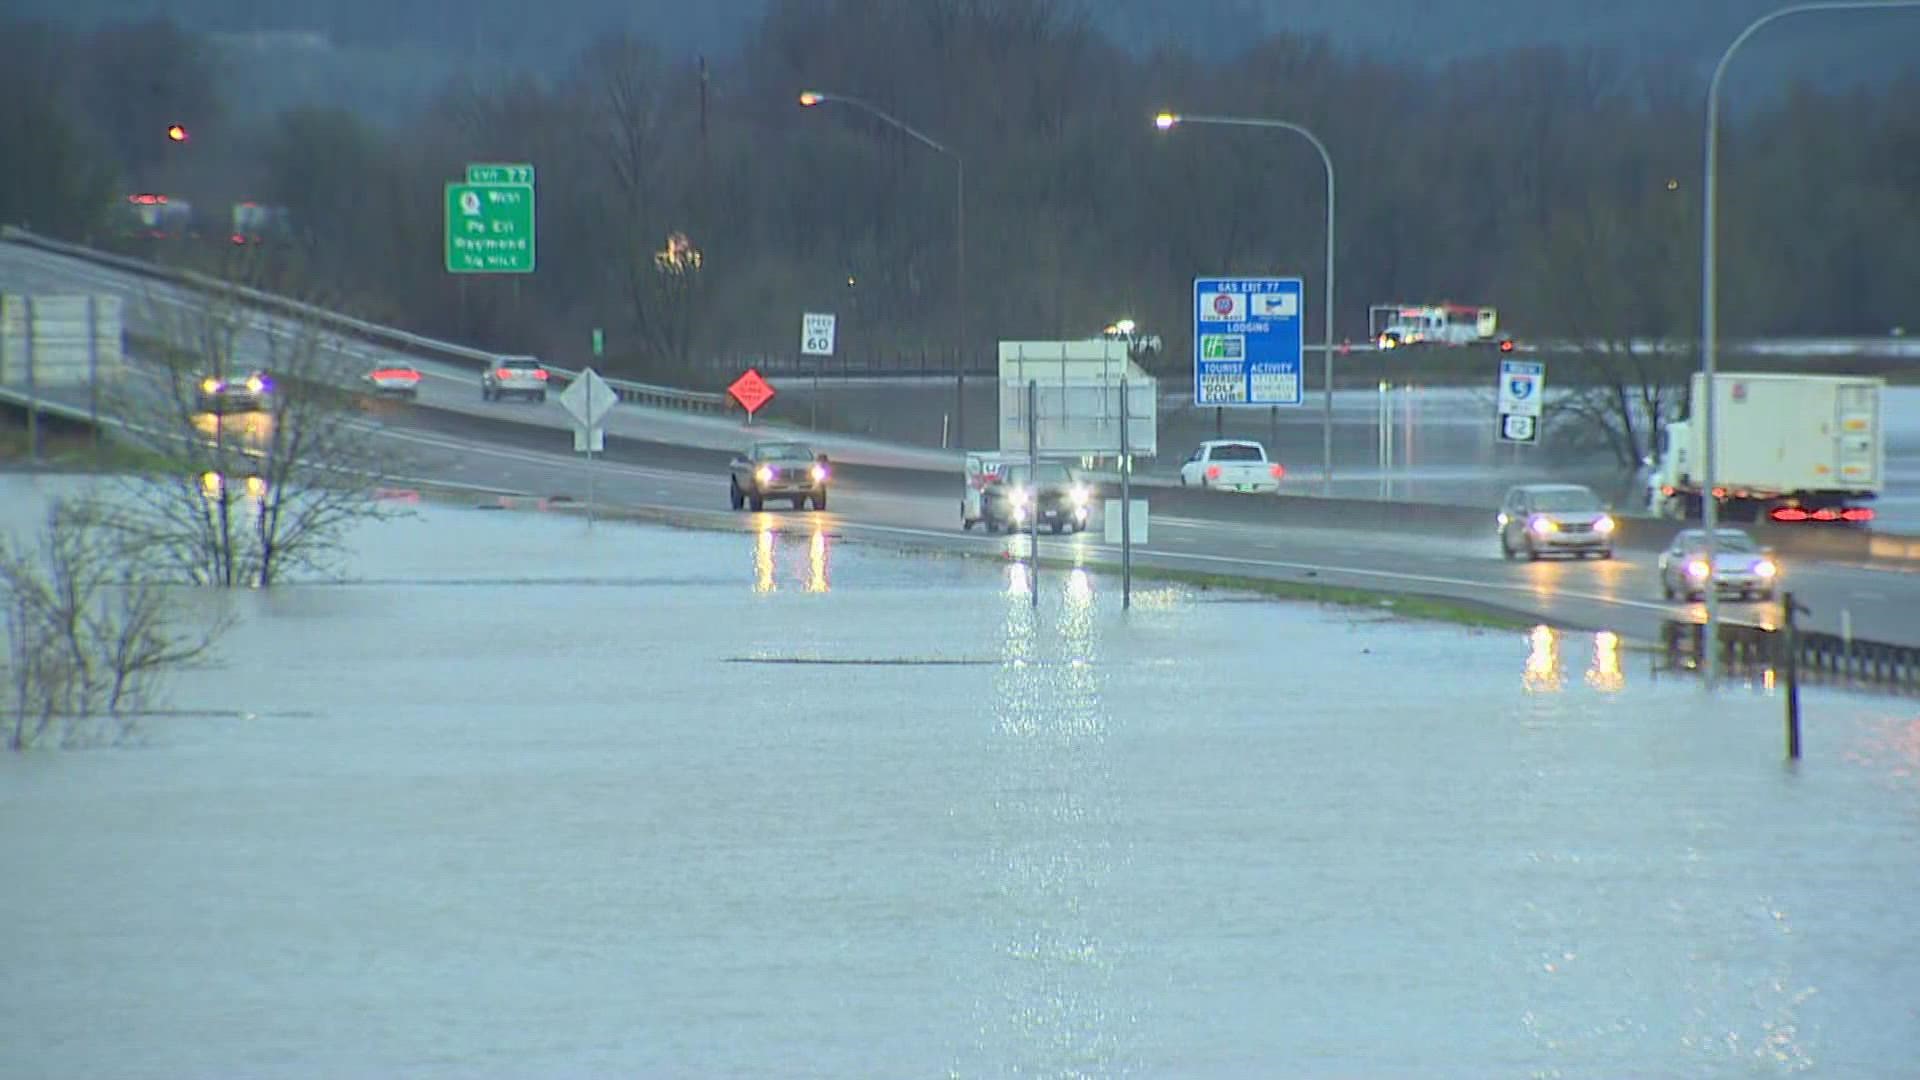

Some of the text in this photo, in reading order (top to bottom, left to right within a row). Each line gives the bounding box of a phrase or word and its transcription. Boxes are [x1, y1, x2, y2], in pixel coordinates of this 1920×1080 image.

[507, 167, 528, 181] 77
[1218, 282, 1280, 292] GAS EXIT 77
[1227, 322, 1270, 333] LODGING
[807, 337, 829, 350] 60
[1205, 363, 1293, 374] TOURIST ACTIVITY
[1206, 384, 1234, 392] GOLF
[1206, 393, 1236, 401] CLUB
